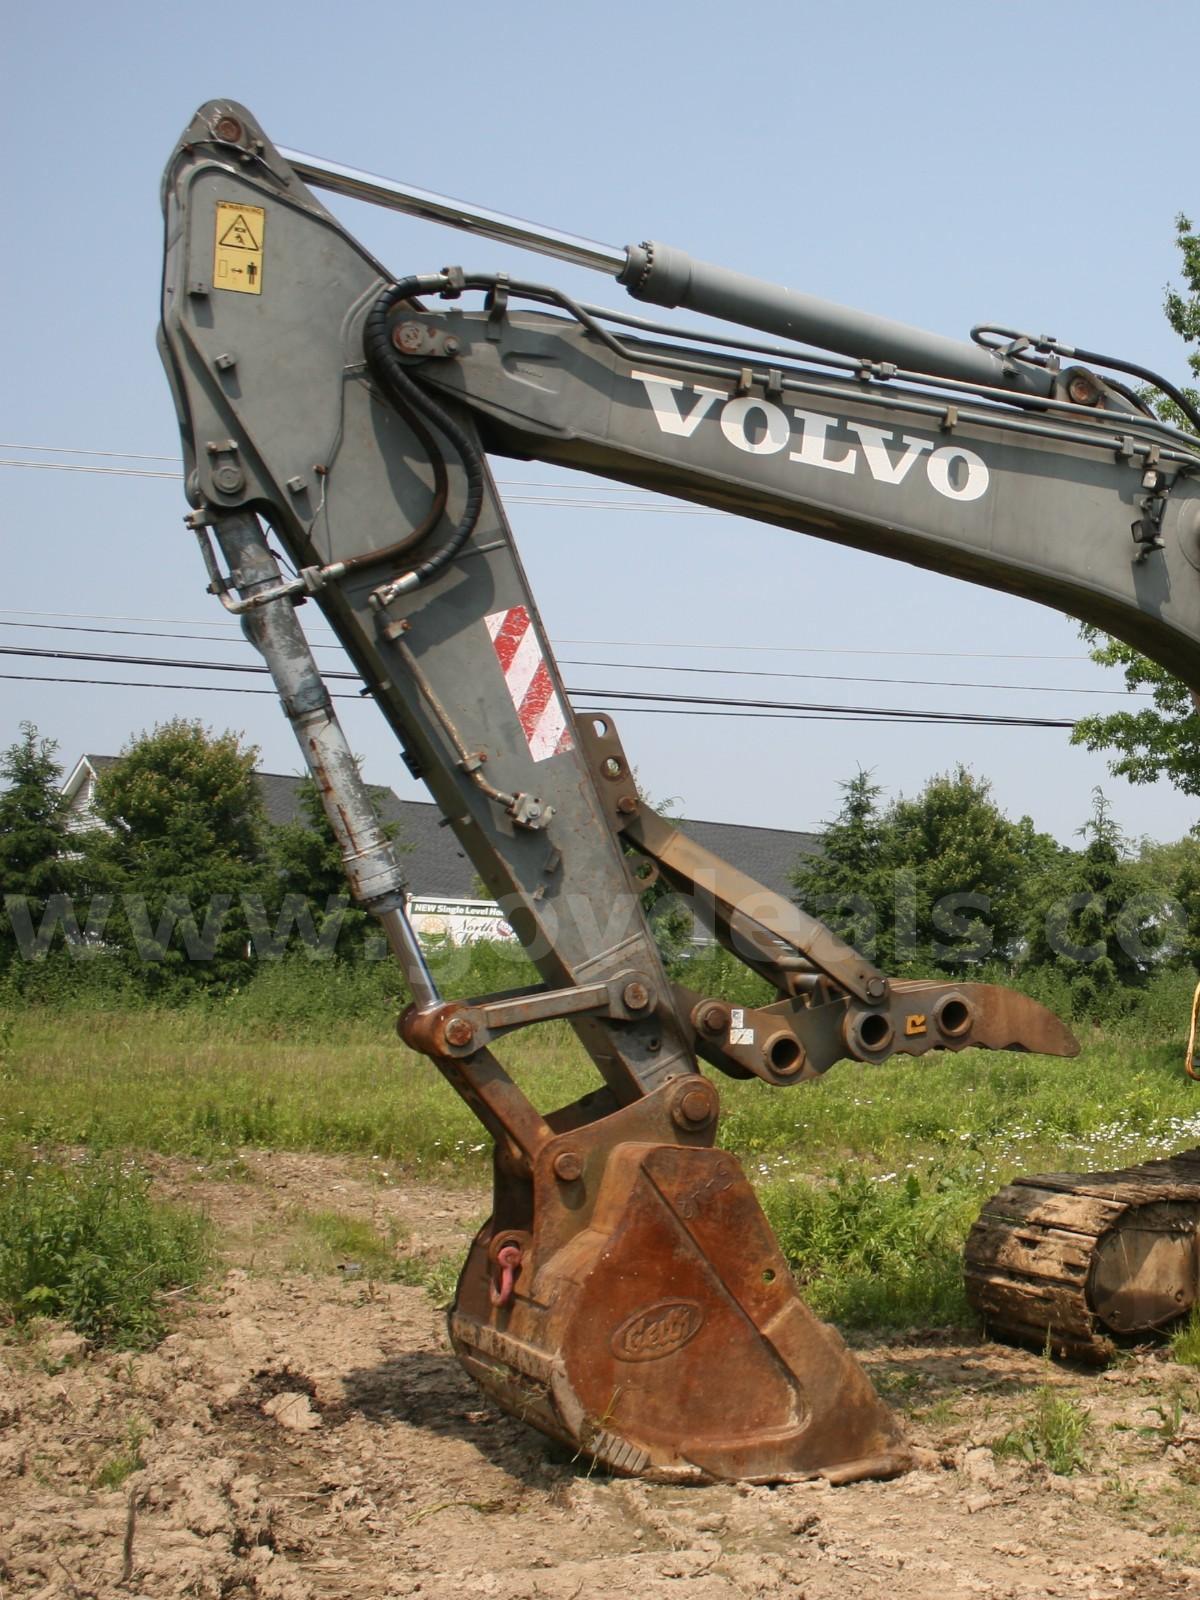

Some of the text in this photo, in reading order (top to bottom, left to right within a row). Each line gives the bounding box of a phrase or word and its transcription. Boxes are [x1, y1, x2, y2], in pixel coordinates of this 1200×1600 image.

[631, 370, 989, 501] VOLVO
[414, 903, 437, 913] NEW
[437, 905, 465, 916] Single
[465, 907, 488, 916] Level
